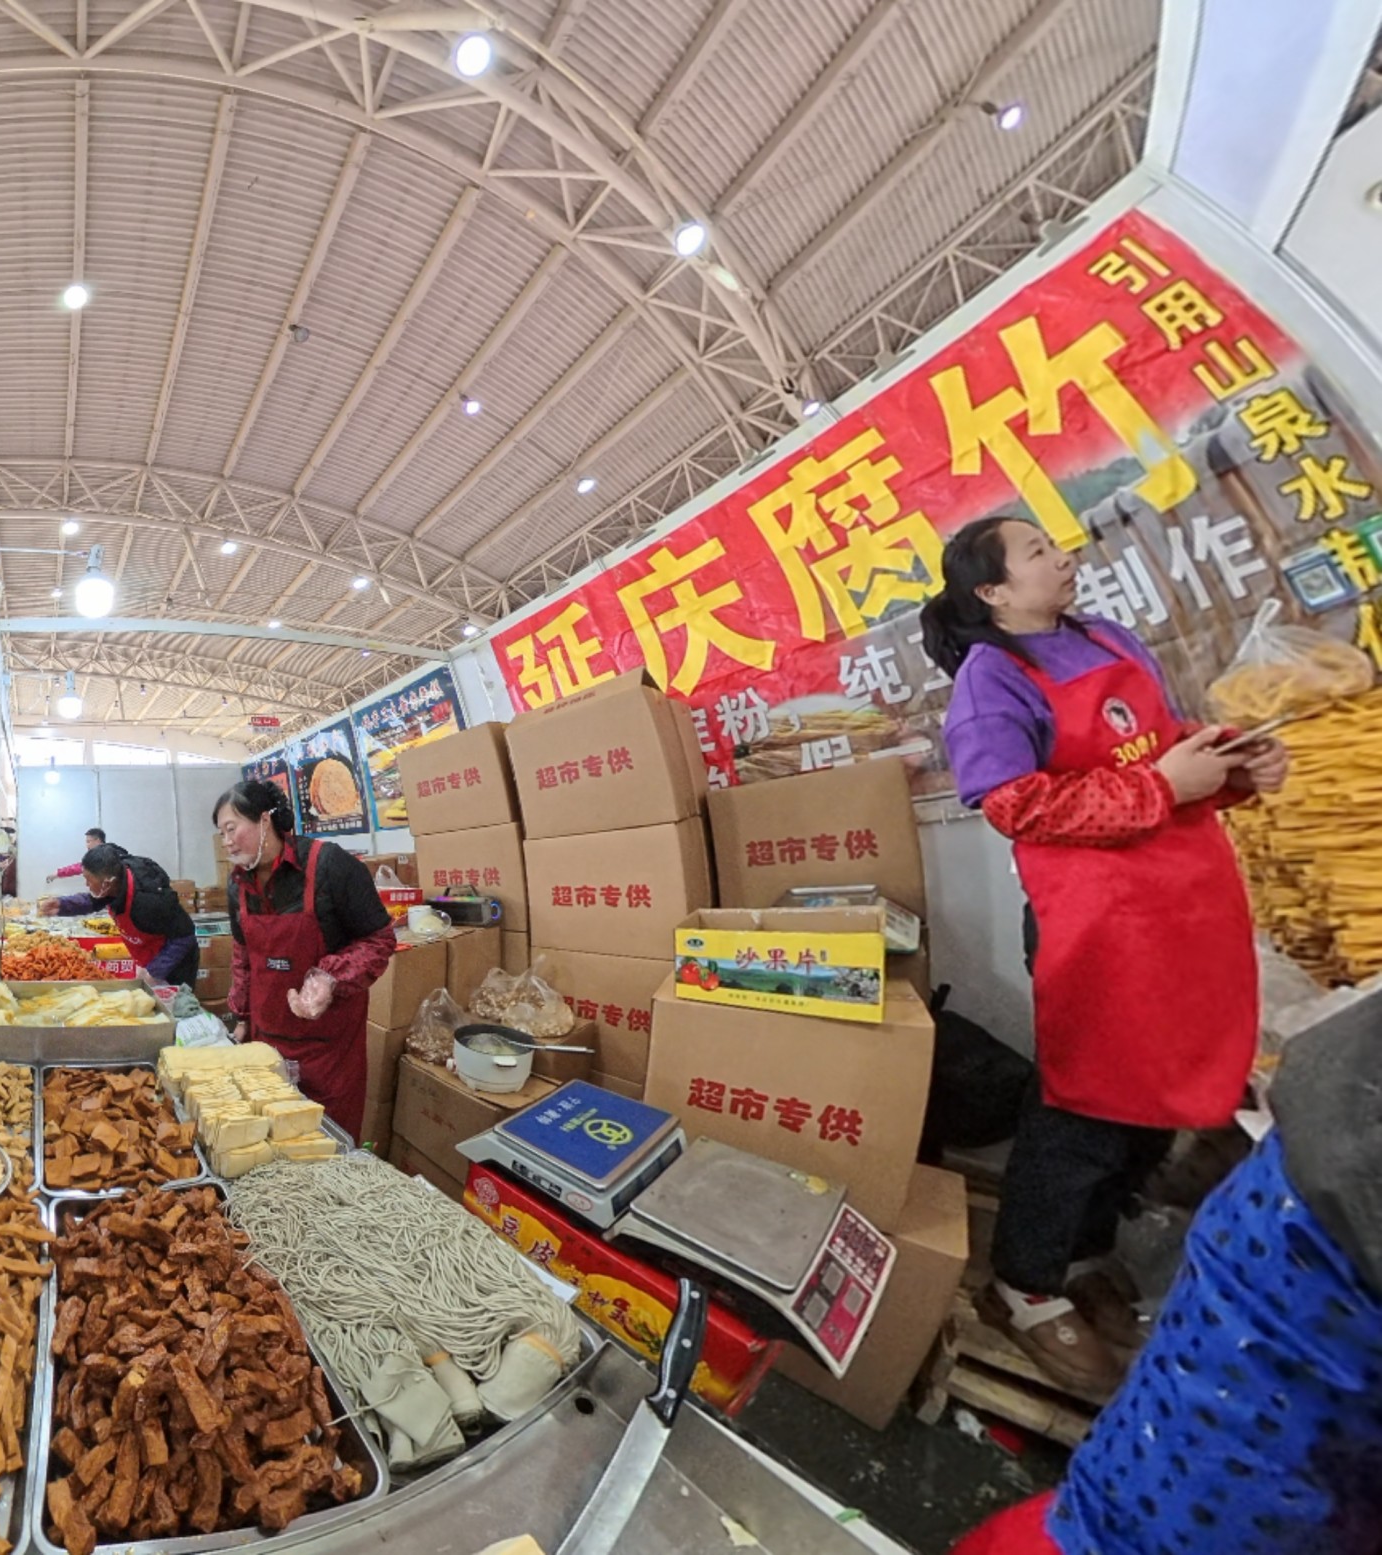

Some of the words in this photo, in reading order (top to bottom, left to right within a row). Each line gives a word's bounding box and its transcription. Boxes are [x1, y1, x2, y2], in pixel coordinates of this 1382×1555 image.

[506, 316, 1198, 712] 延庆腐竹
[416, 766, 482, 798] 超市专供
[535, 747, 634, 790] 超市专供
[745, 828, 879, 868] 超市专供
[433, 866, 501, 888] 超市专供
[551, 884, 652, 908] 超市专供
[735, 947, 819, 974] 沙果片
[687, 1077, 864, 1147] 超市专供
[492, 1215, 557, 1274] 豆皮
